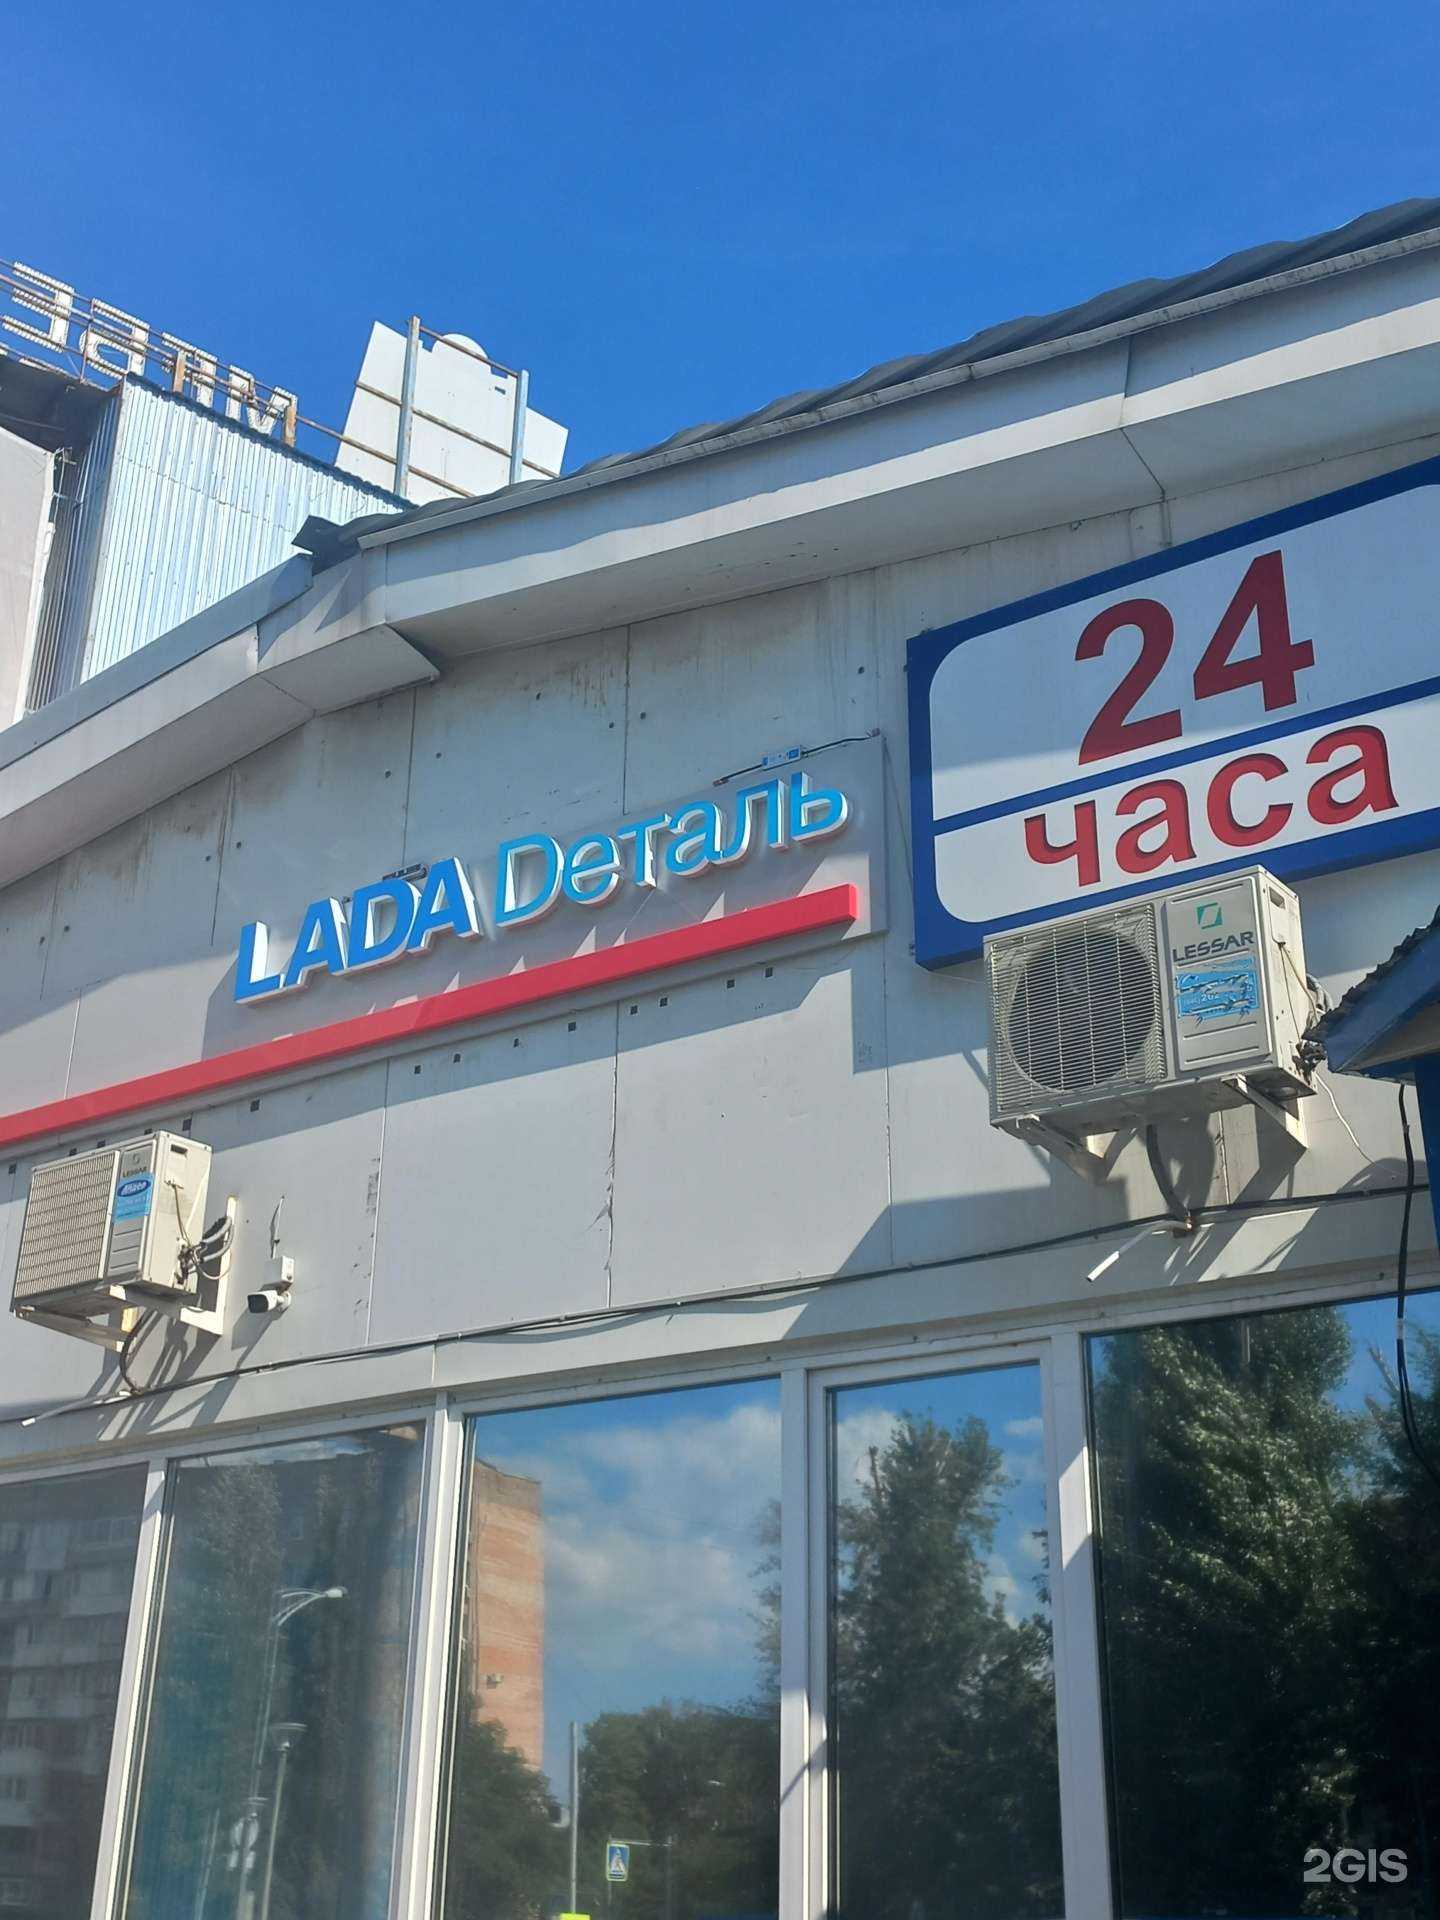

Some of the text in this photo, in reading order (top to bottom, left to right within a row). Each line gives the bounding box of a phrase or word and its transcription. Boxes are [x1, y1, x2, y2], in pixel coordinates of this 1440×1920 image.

[1075, 549, 1315, 766] 24
[1023, 725, 1399, 887] часа
[234, 857, 480, 1004] LADA
[1172, 931, 1254, 962] LESSAR
